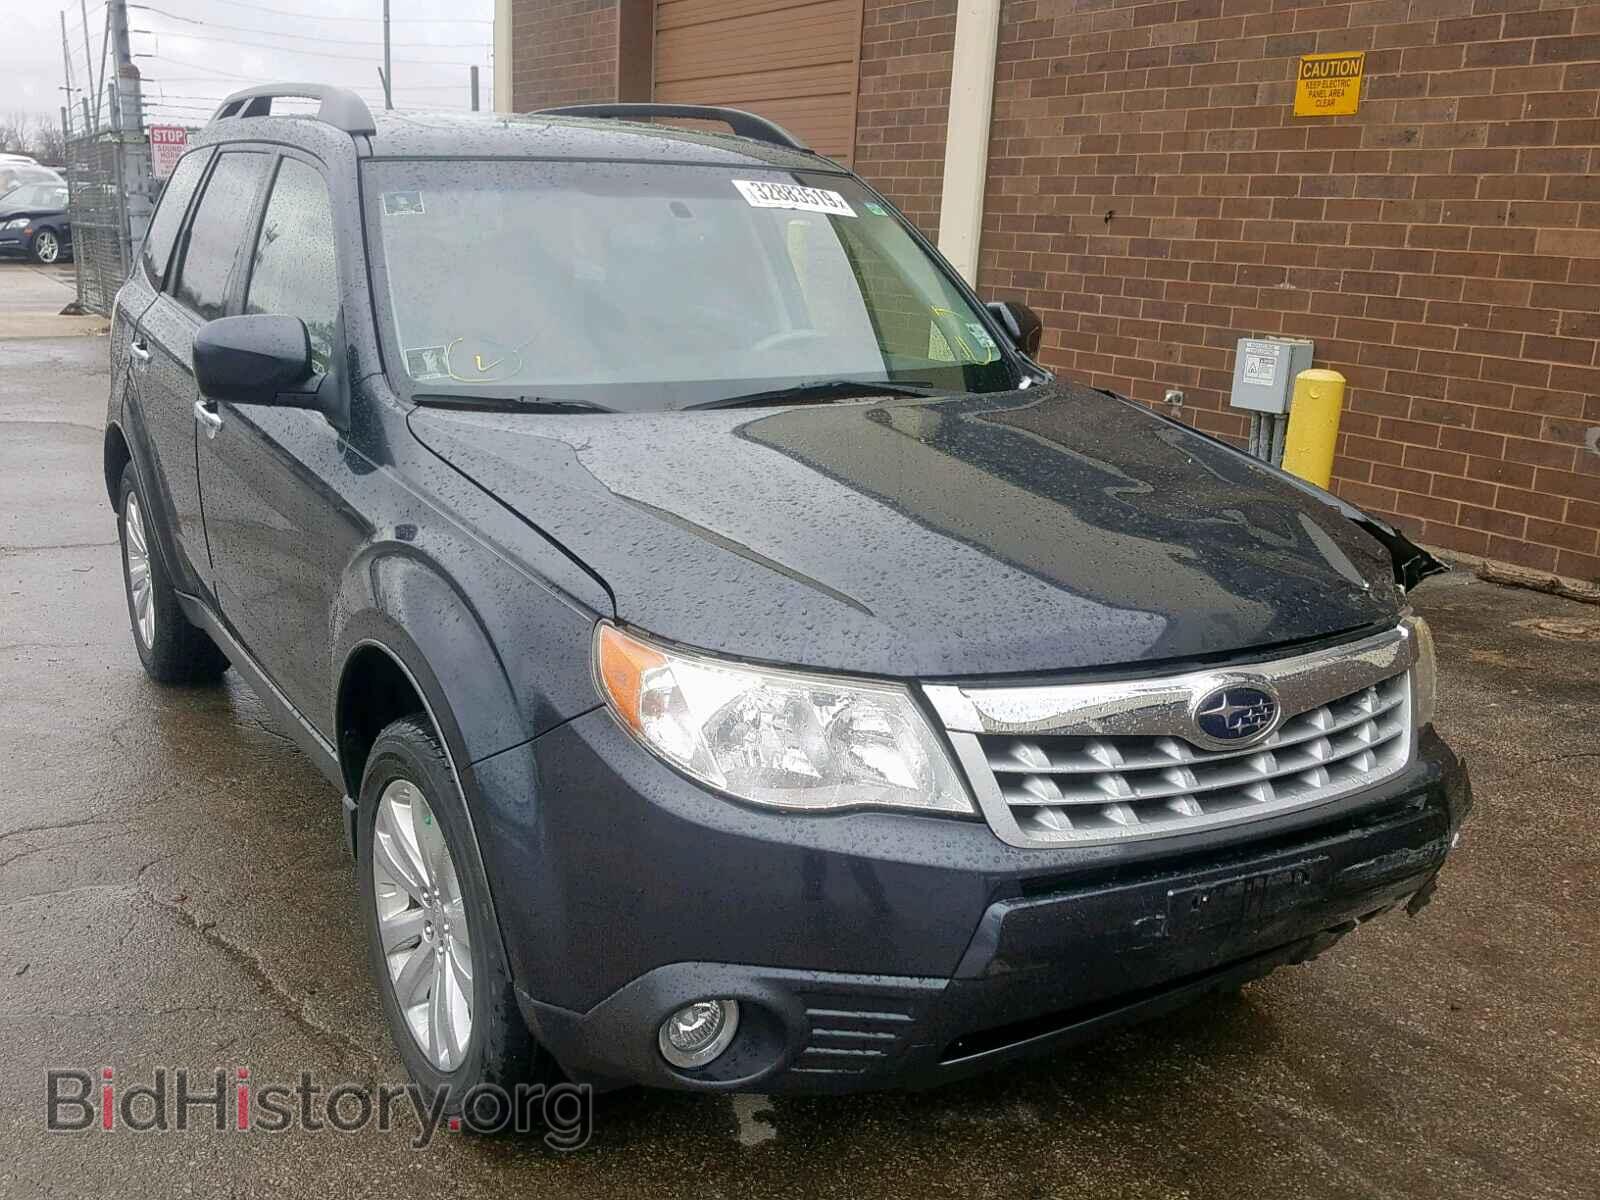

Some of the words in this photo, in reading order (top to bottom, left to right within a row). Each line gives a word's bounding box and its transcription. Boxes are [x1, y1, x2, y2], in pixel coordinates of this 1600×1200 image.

[1303, 60, 1359, 77] CAUTION
[1306, 81, 1321, 89] KEEP
[1322, 79, 1351, 88] ELECTRIC
[1308, 90, 1327, 98] PANEL
[1329, 89, 1345, 97] AREA
[1315, 98, 1336, 107] CLEAR
[153, 129, 183, 142] STOP
